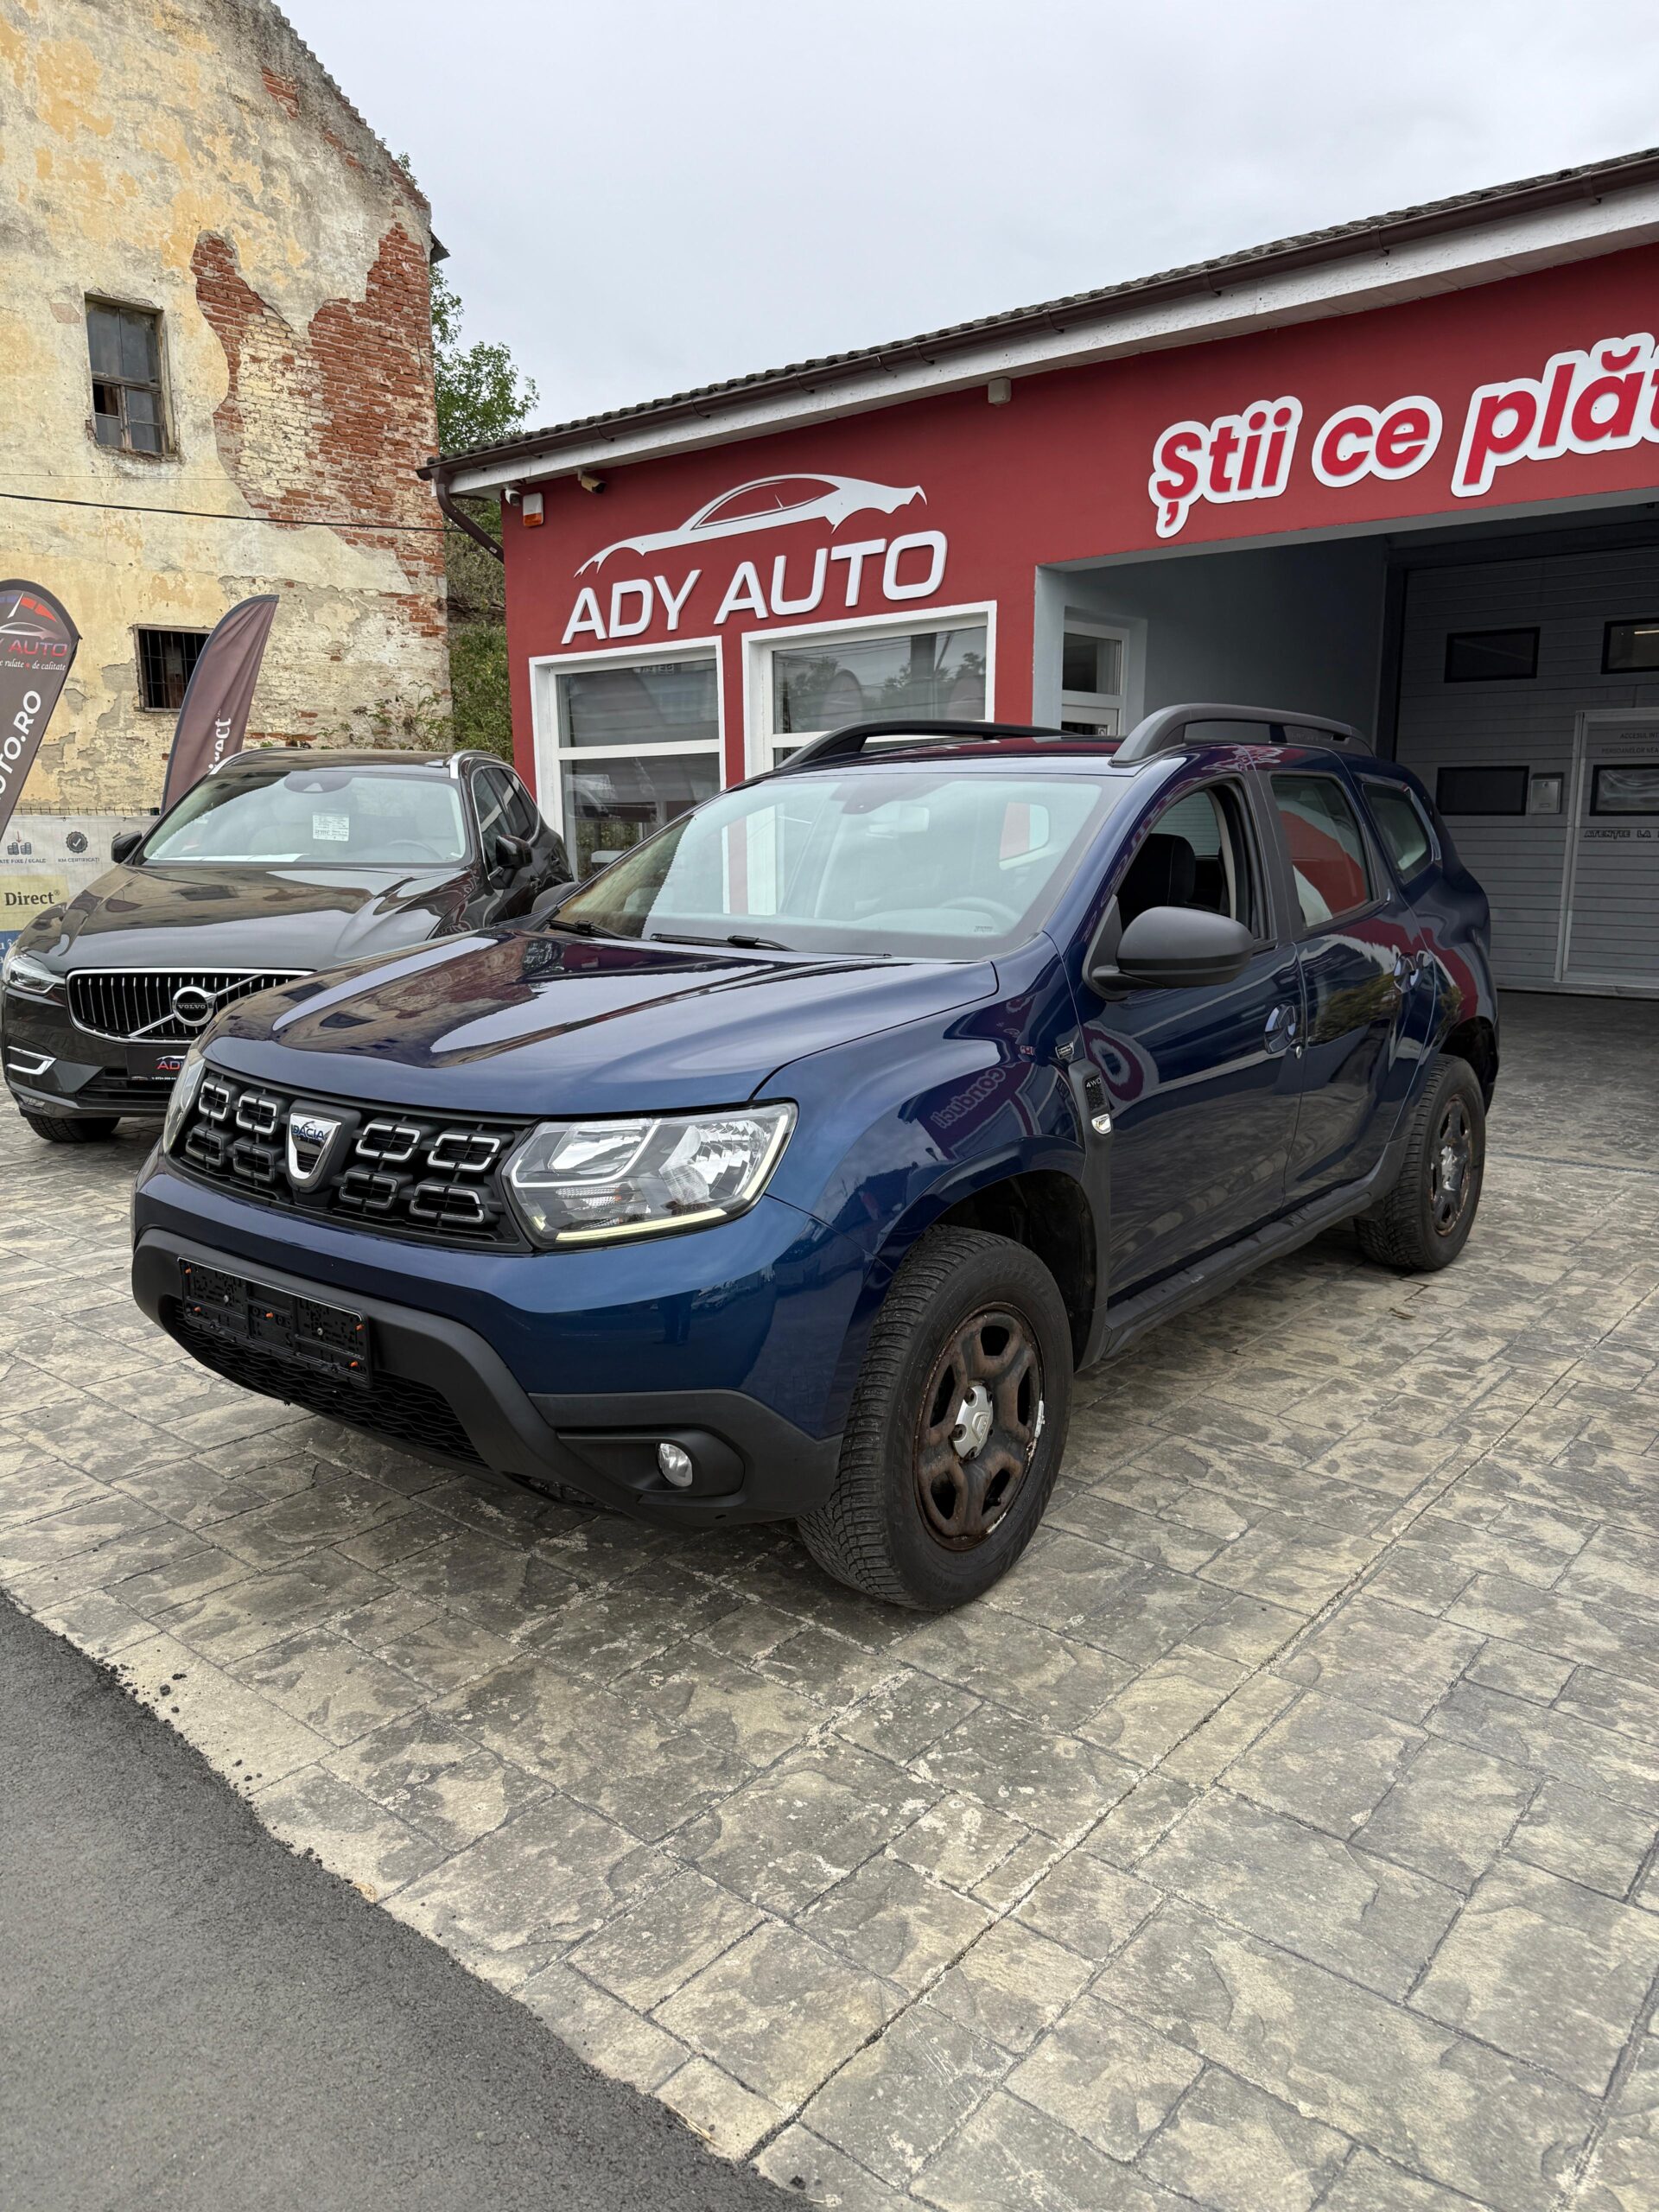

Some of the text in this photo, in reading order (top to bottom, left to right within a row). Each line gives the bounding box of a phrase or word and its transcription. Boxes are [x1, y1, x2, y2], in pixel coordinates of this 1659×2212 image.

[1154, 403, 1296, 531] Știi
[1317, 403, 1435, 481] ce
[561, 531, 947, 644] ADY AUTO
[8, 639, 68, 657] AUTO
[4, 658, 24, 668] rulate
[32, 660, 40, 670] de
[41, 661, 67, 671] calitate
[1637, 829, 1651, 838] LA
[1086, 1077, 1102, 1088] 4WD
[290, 1123, 325, 1141] DACIA
